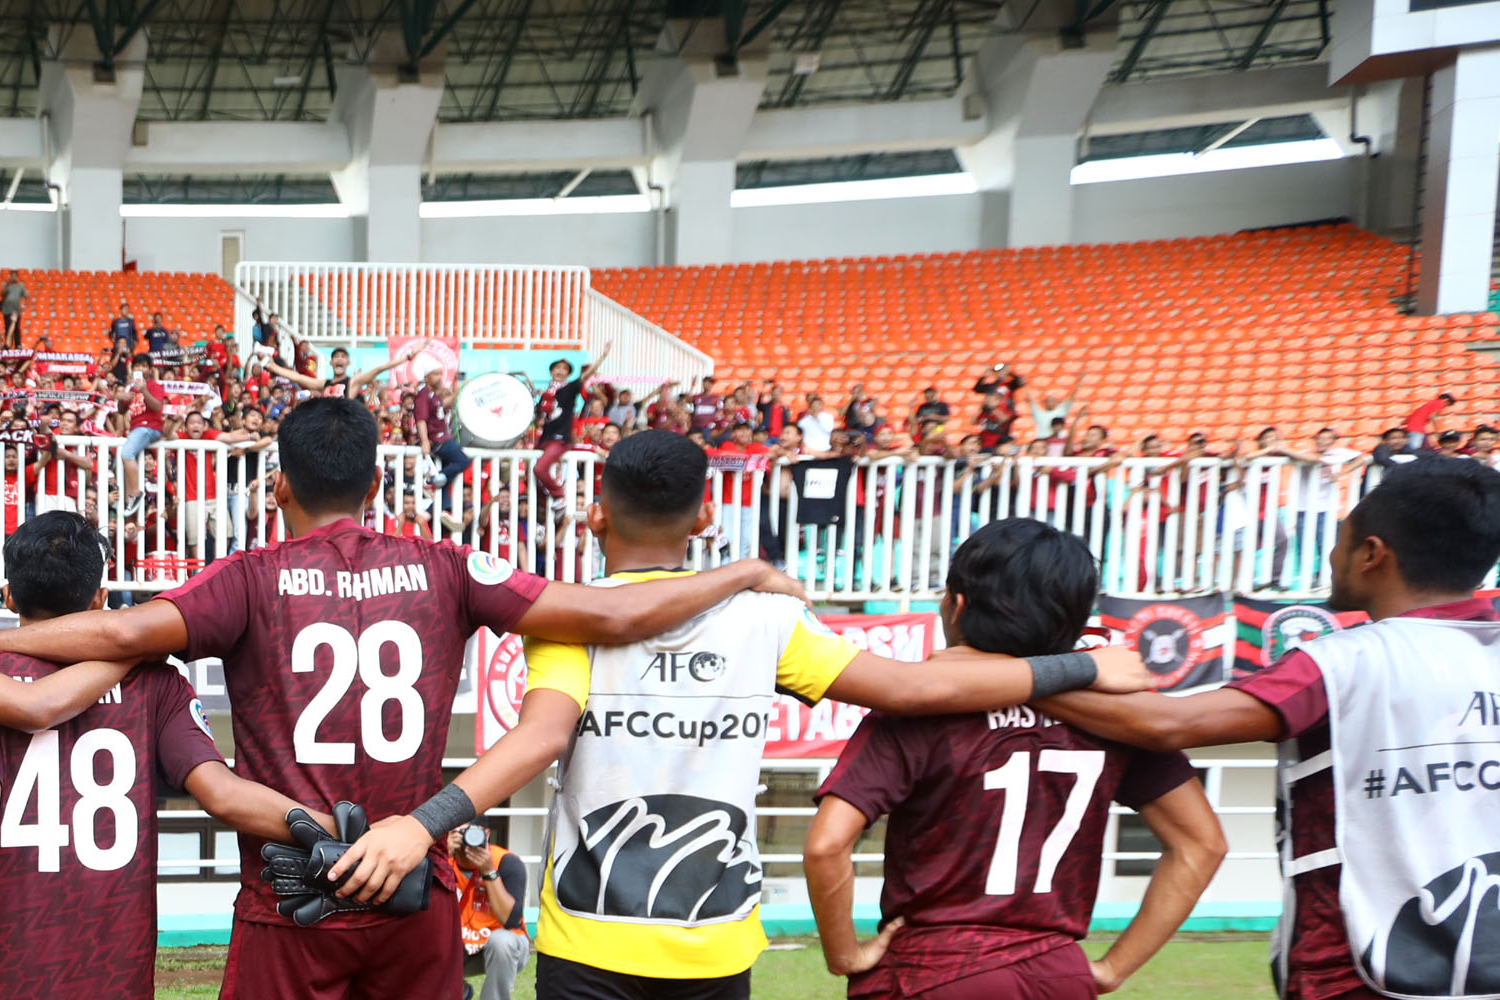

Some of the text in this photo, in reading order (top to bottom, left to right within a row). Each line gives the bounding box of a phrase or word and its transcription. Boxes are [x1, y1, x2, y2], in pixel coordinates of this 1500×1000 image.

[278, 564, 428, 602] ABD. RHMAN
[291, 620, 425, 765] 28
[641, 651, 726, 683] AFC
[0, 727, 138, 872] 48
[984, 750, 1105, 896] 17
